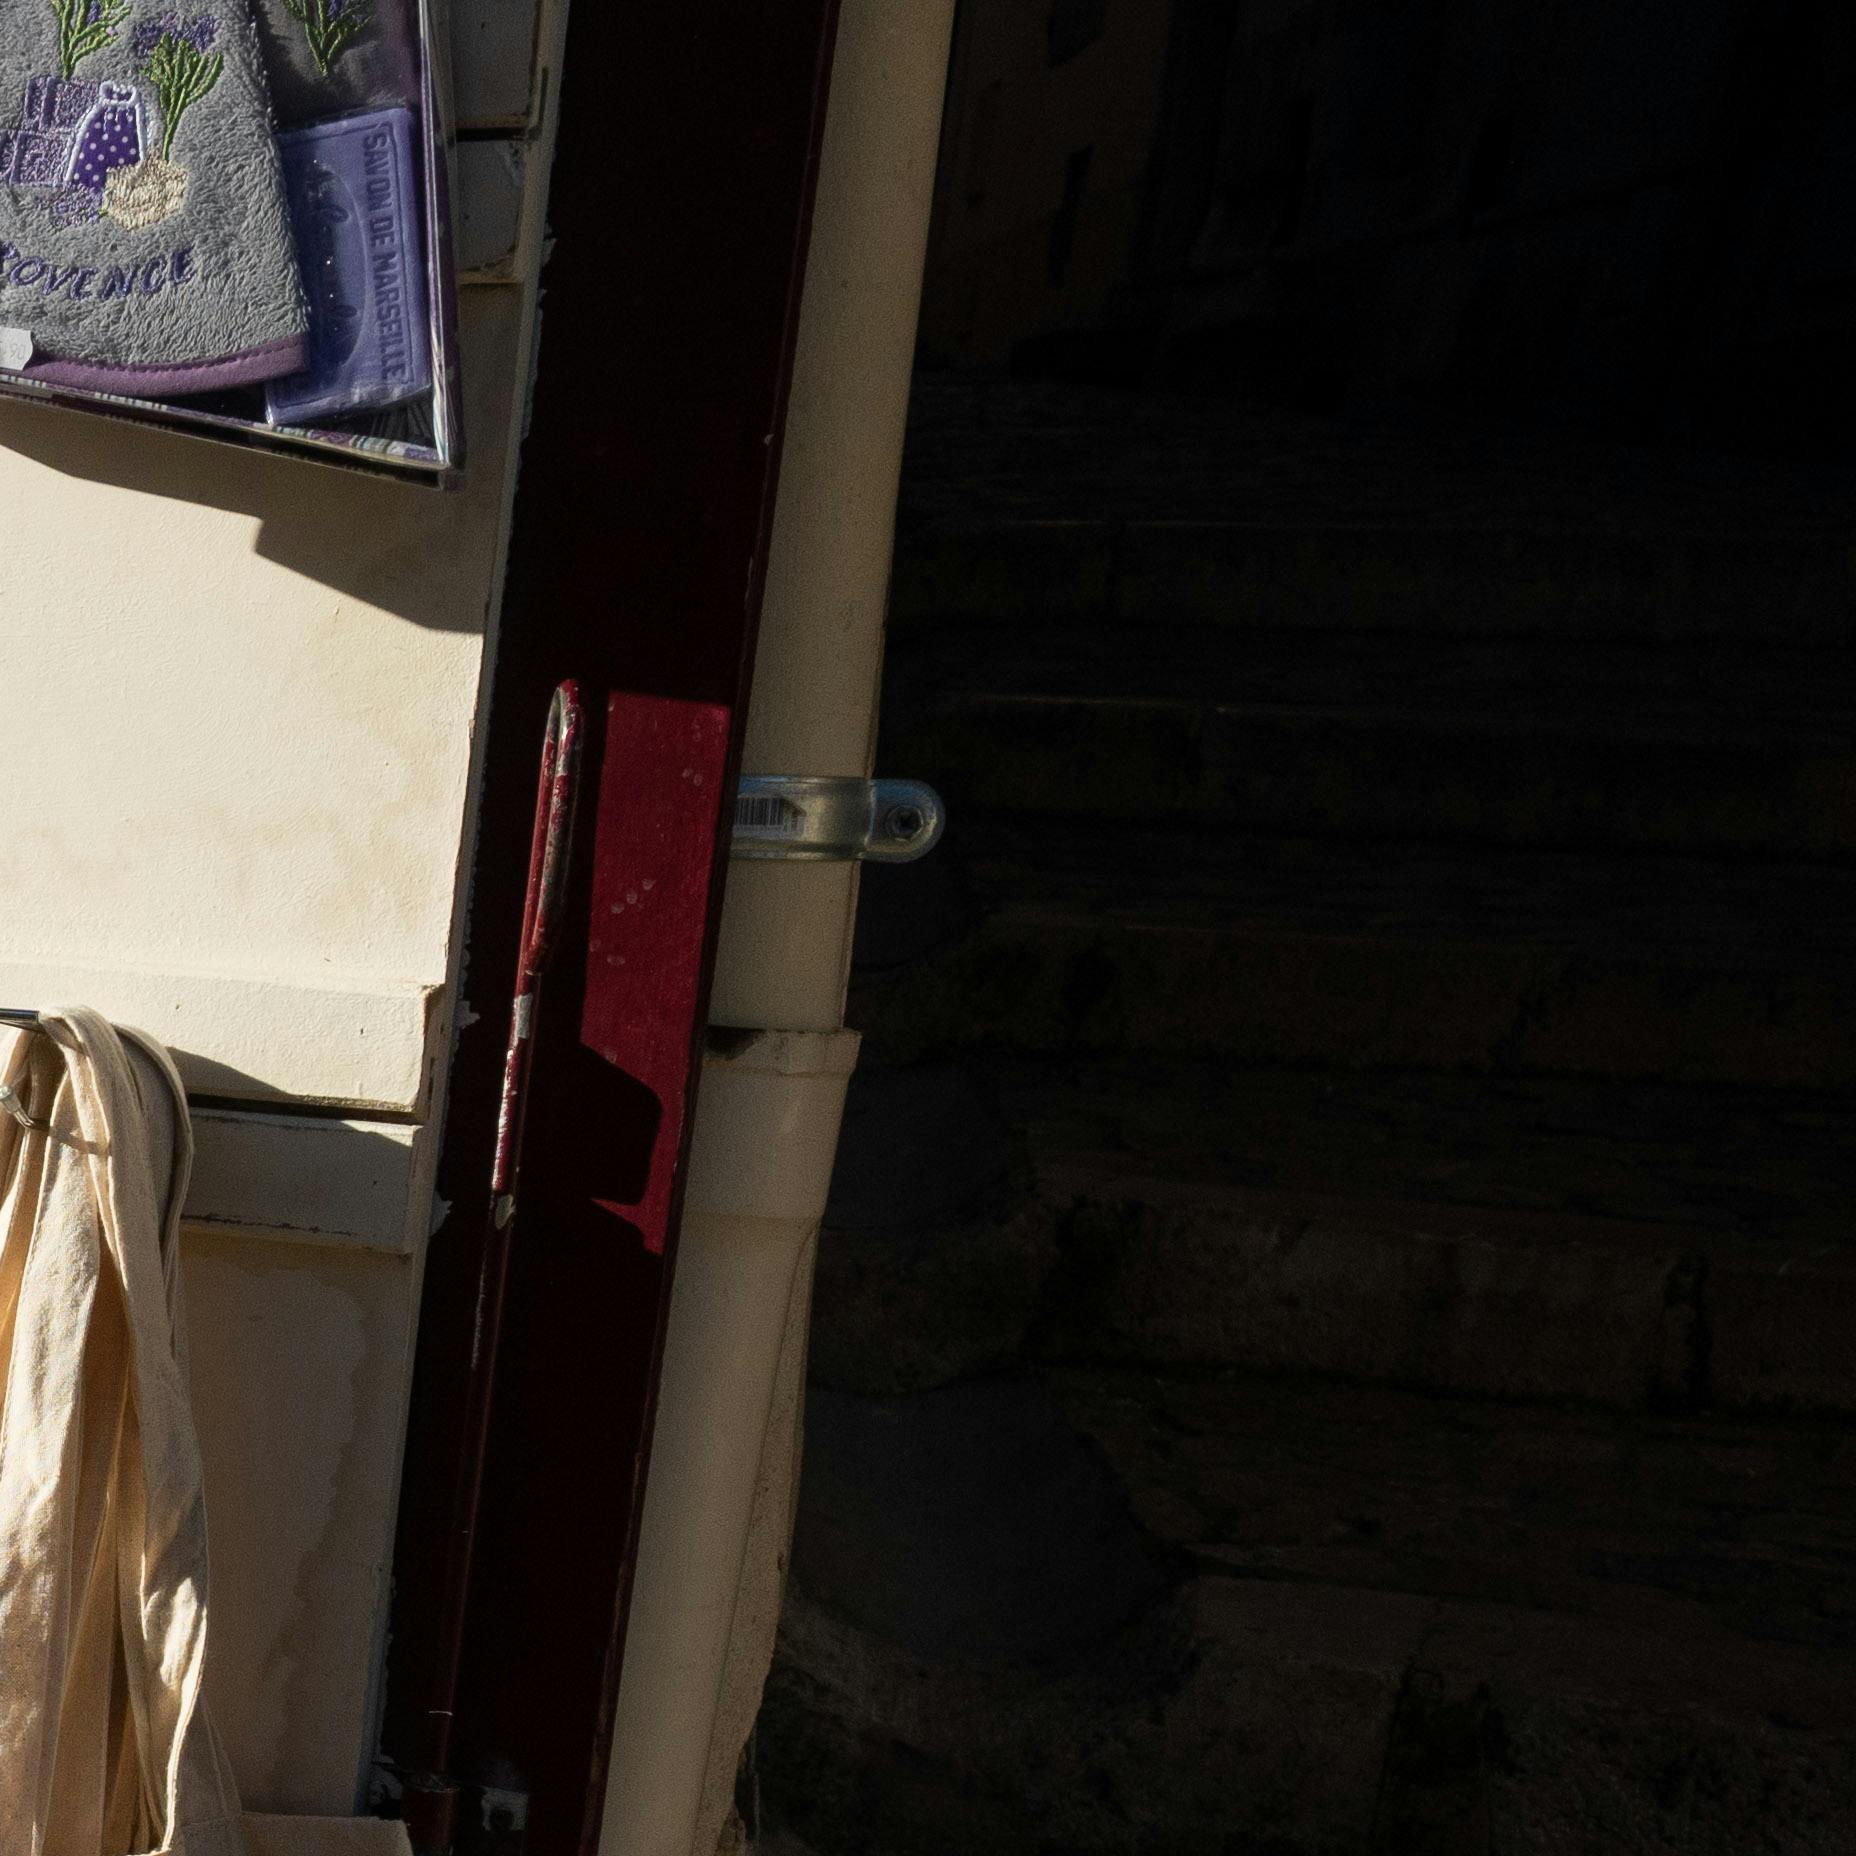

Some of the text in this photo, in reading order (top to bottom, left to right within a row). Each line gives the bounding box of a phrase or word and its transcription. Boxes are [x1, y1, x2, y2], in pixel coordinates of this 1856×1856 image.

[2, 242, 196, 301] OVENCE
[363, 132, 407, 381] SAVON DE MARSEILLE
